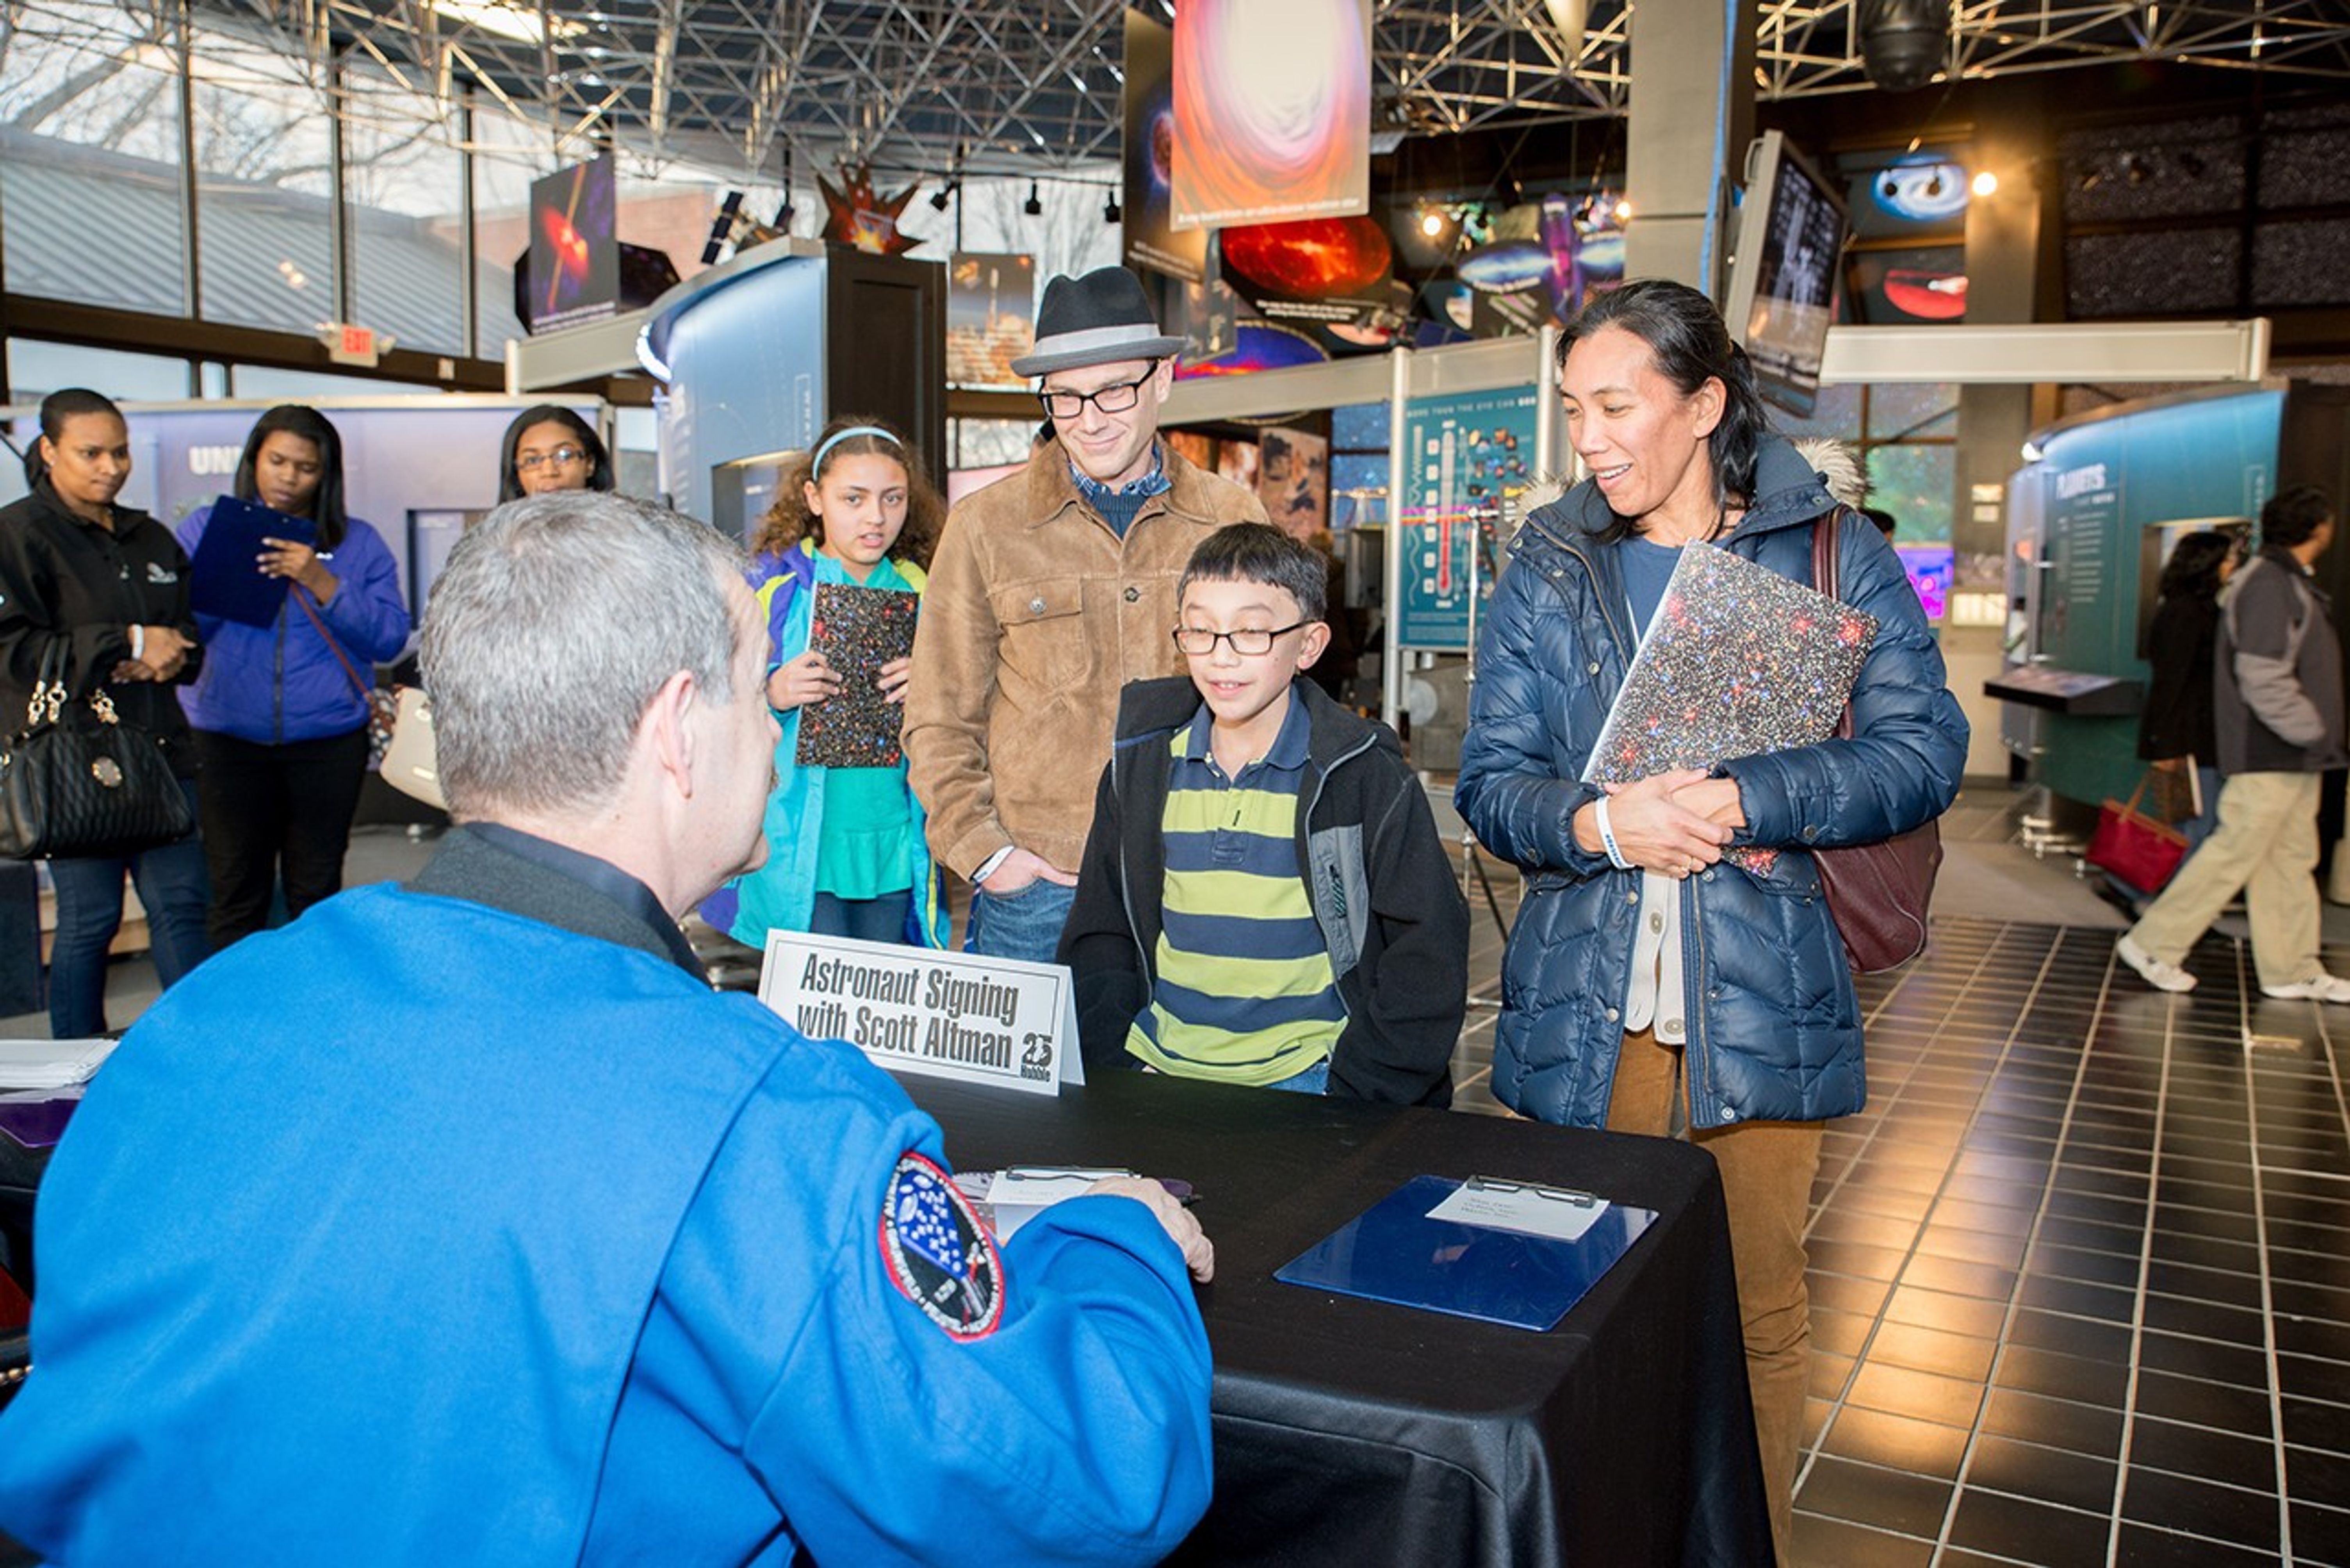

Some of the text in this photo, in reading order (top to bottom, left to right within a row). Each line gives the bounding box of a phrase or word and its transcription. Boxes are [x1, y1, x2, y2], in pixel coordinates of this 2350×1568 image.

[344, 330, 371, 353] EXIT
[800, 953, 1019, 1026] Astronaut Signing
[797, 1001, 1012, 1069] with Scott Altman
